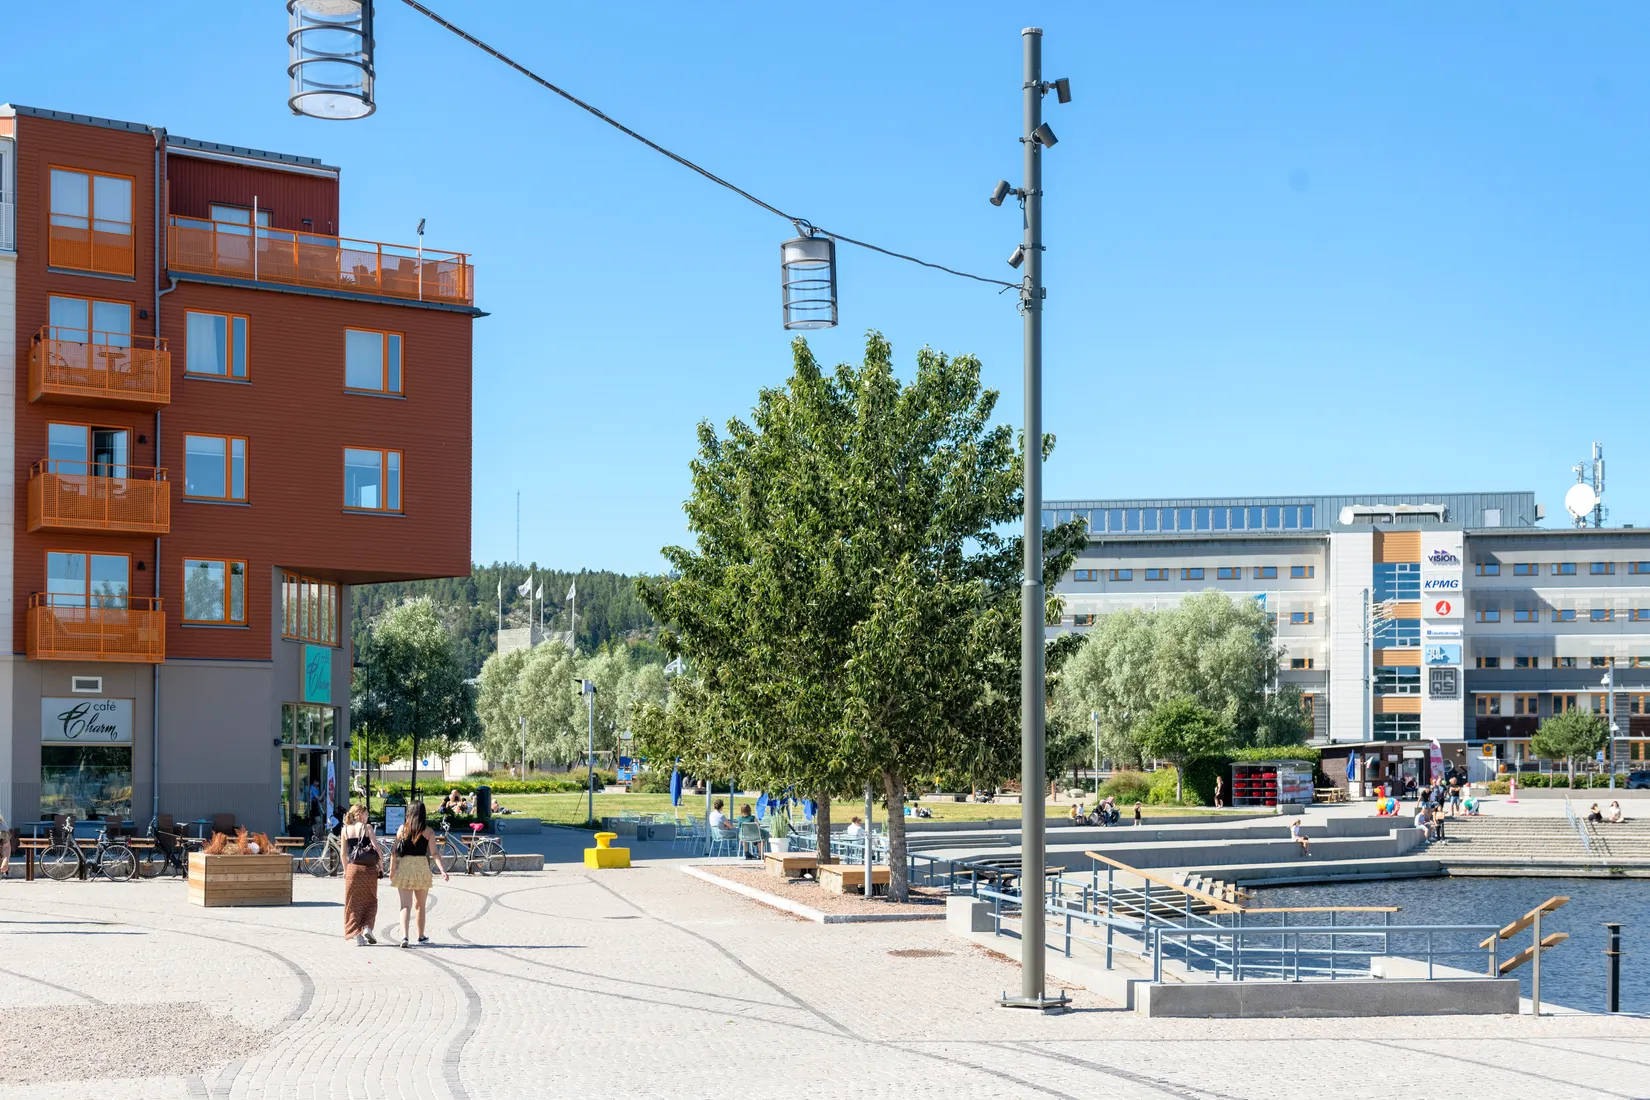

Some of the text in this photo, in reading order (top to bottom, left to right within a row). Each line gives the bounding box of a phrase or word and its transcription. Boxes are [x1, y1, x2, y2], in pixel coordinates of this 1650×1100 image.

[1428, 552, 1456, 562] vision
[1424, 580, 1459, 588] KPMG
[1437, 601, 1449, 615] 4
[1429, 654, 1445, 662] per
[93, 700, 116, 712] café
[57, 702, 118, 740] Charm
